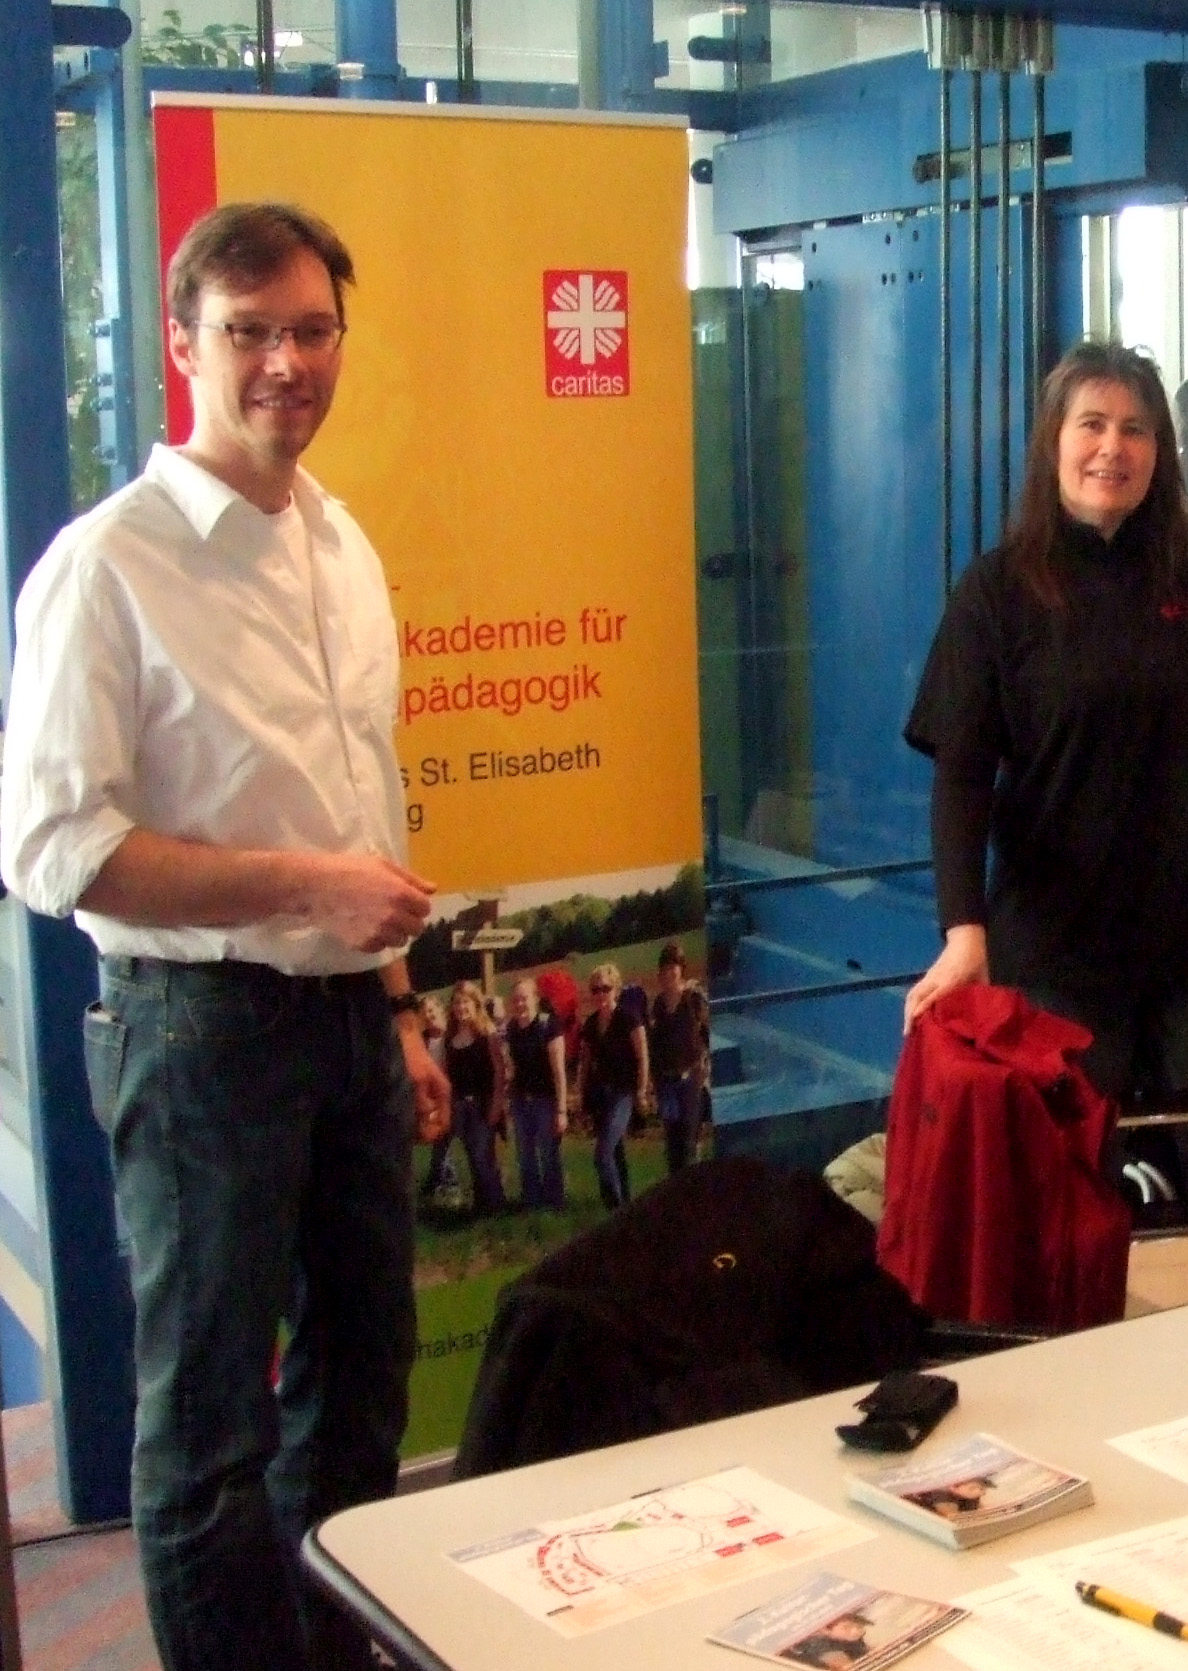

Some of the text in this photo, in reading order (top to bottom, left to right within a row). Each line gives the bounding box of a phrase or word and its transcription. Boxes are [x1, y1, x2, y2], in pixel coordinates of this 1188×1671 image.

[551, 371, 625, 397] caritas
[399, 607, 628, 659] kademie für
[399, 664, 602, 725] pädagogik
[420, 757, 458, 788] St.
[469, 741, 601, 781] Elisabeth
